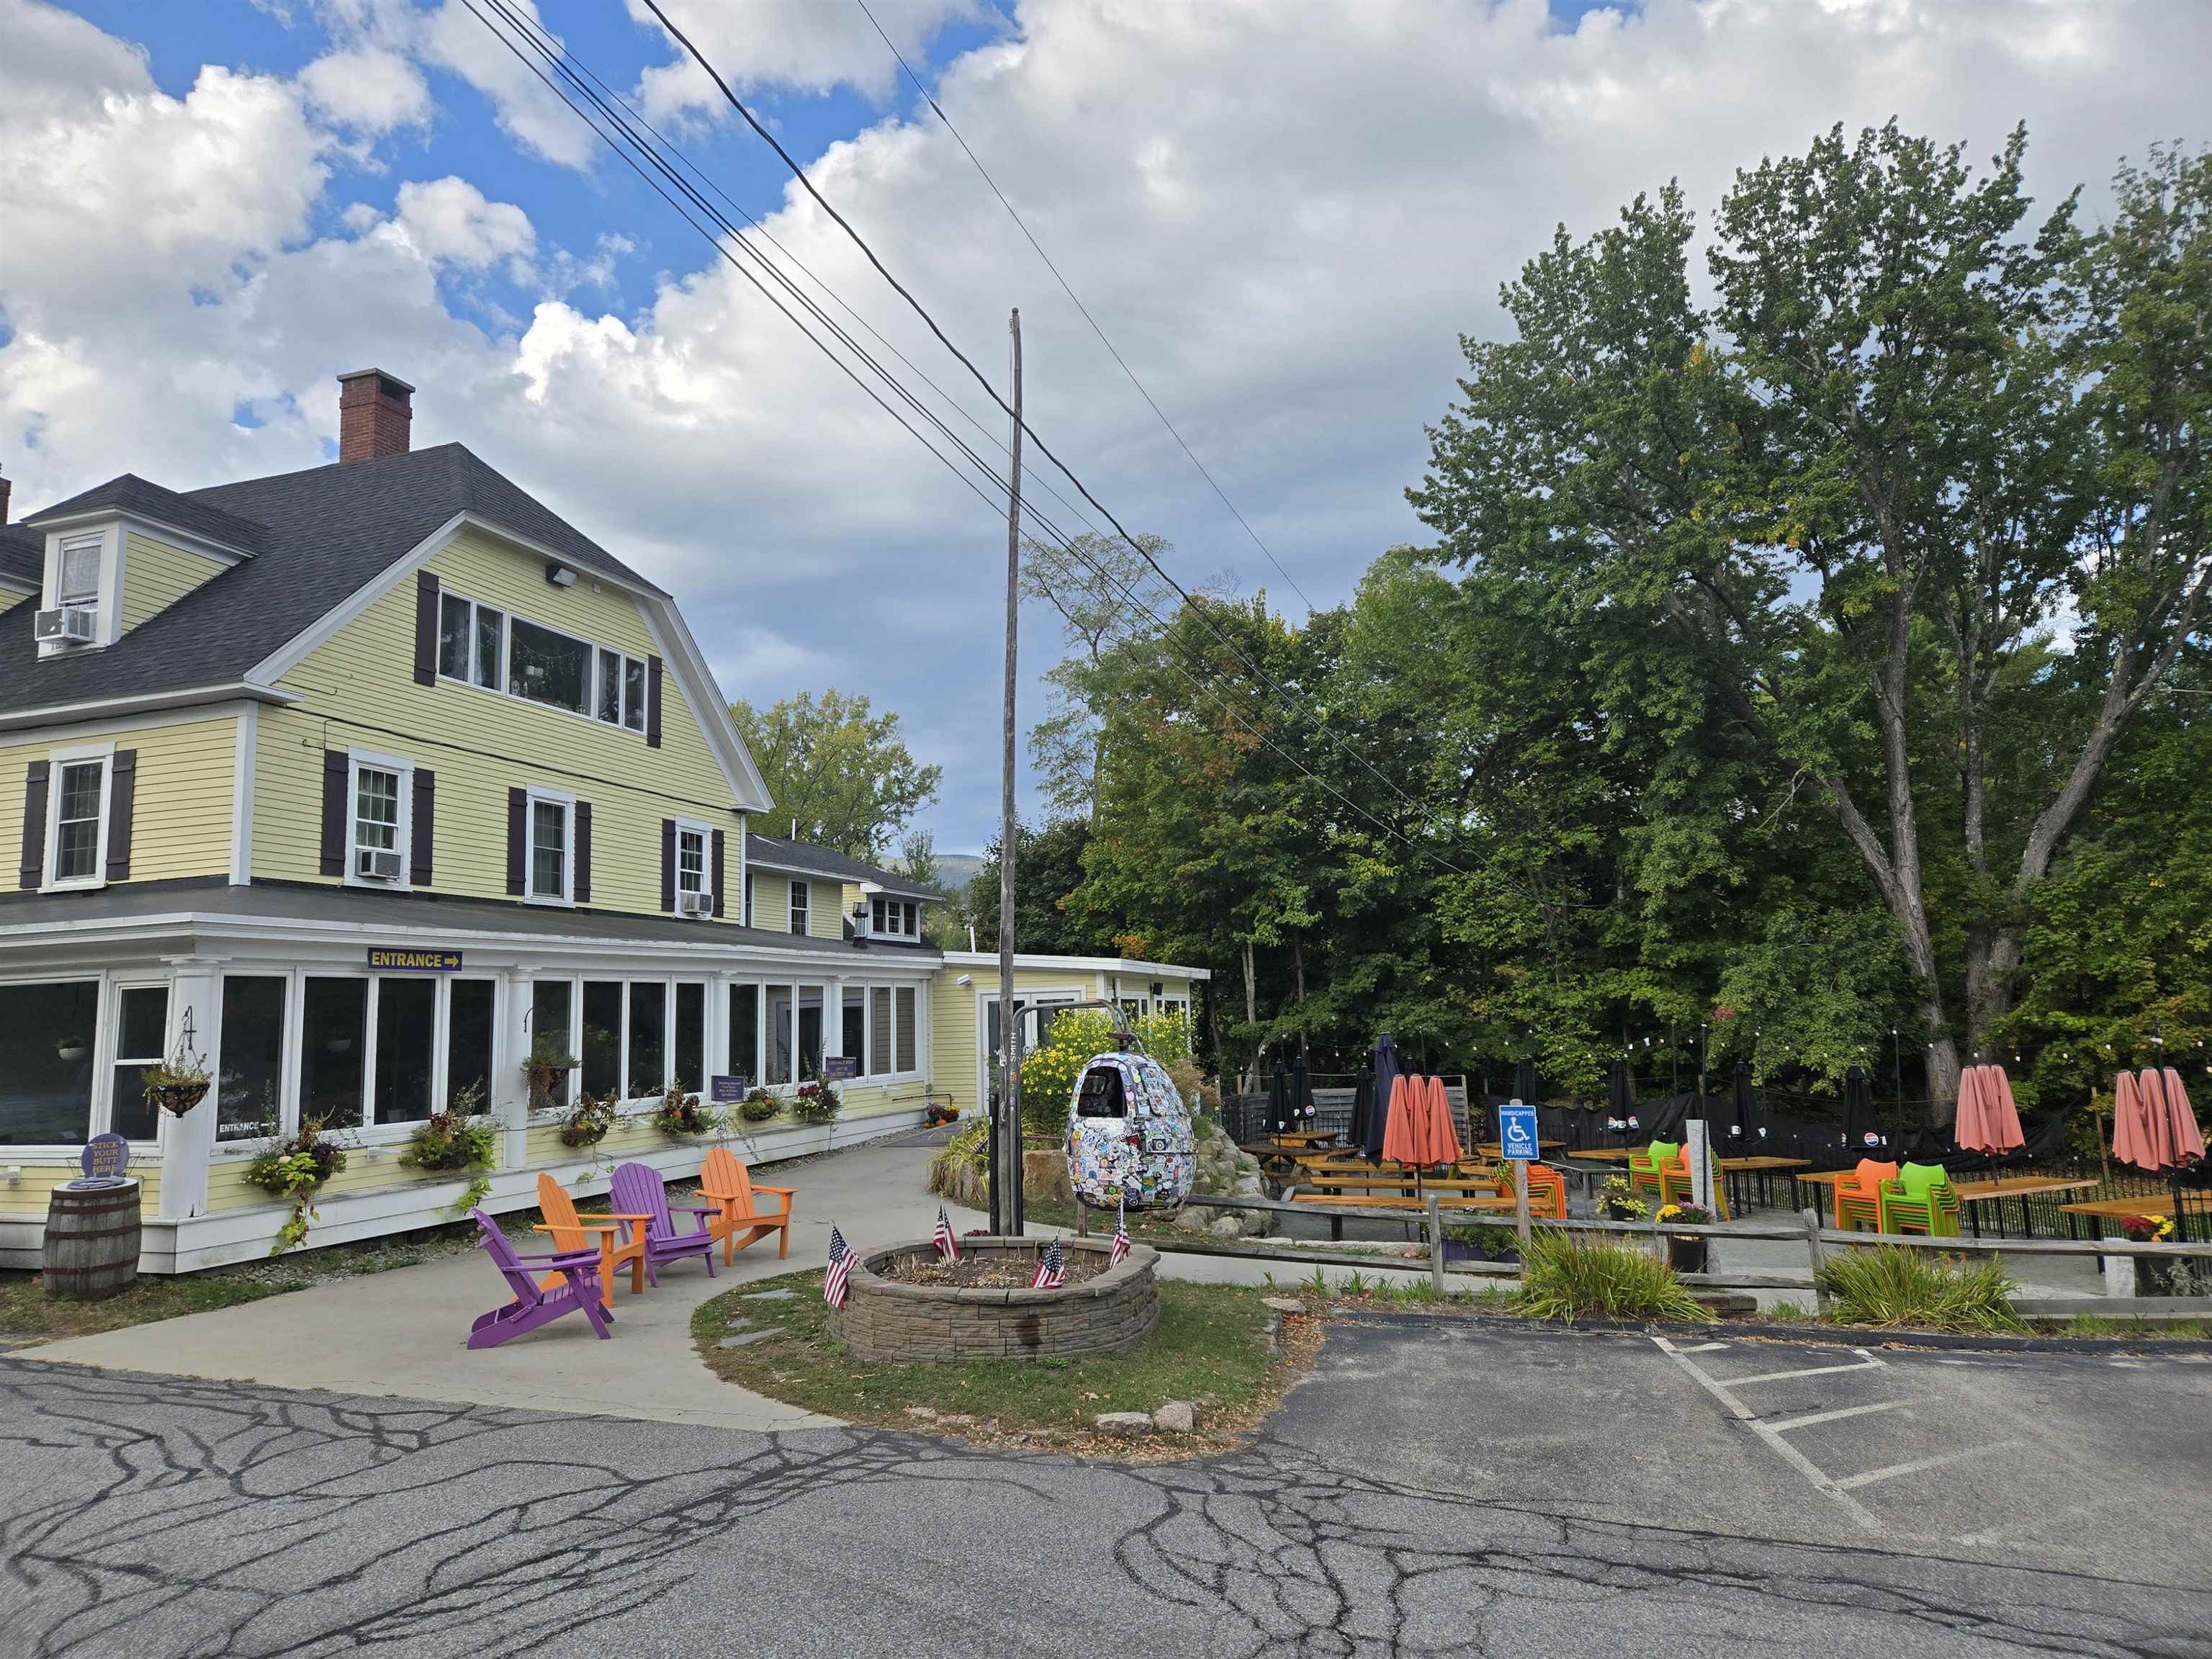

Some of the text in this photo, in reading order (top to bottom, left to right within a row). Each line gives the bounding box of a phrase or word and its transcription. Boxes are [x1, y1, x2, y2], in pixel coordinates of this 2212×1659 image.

[371, 951, 442, 968] ENTRANCE
[91, 1141, 118, 1149] STICK
[93, 1148, 119, 1157] YOUR
[93, 1156, 117, 1165] BUTT
[92, 1164, 117, 1173] HERE
